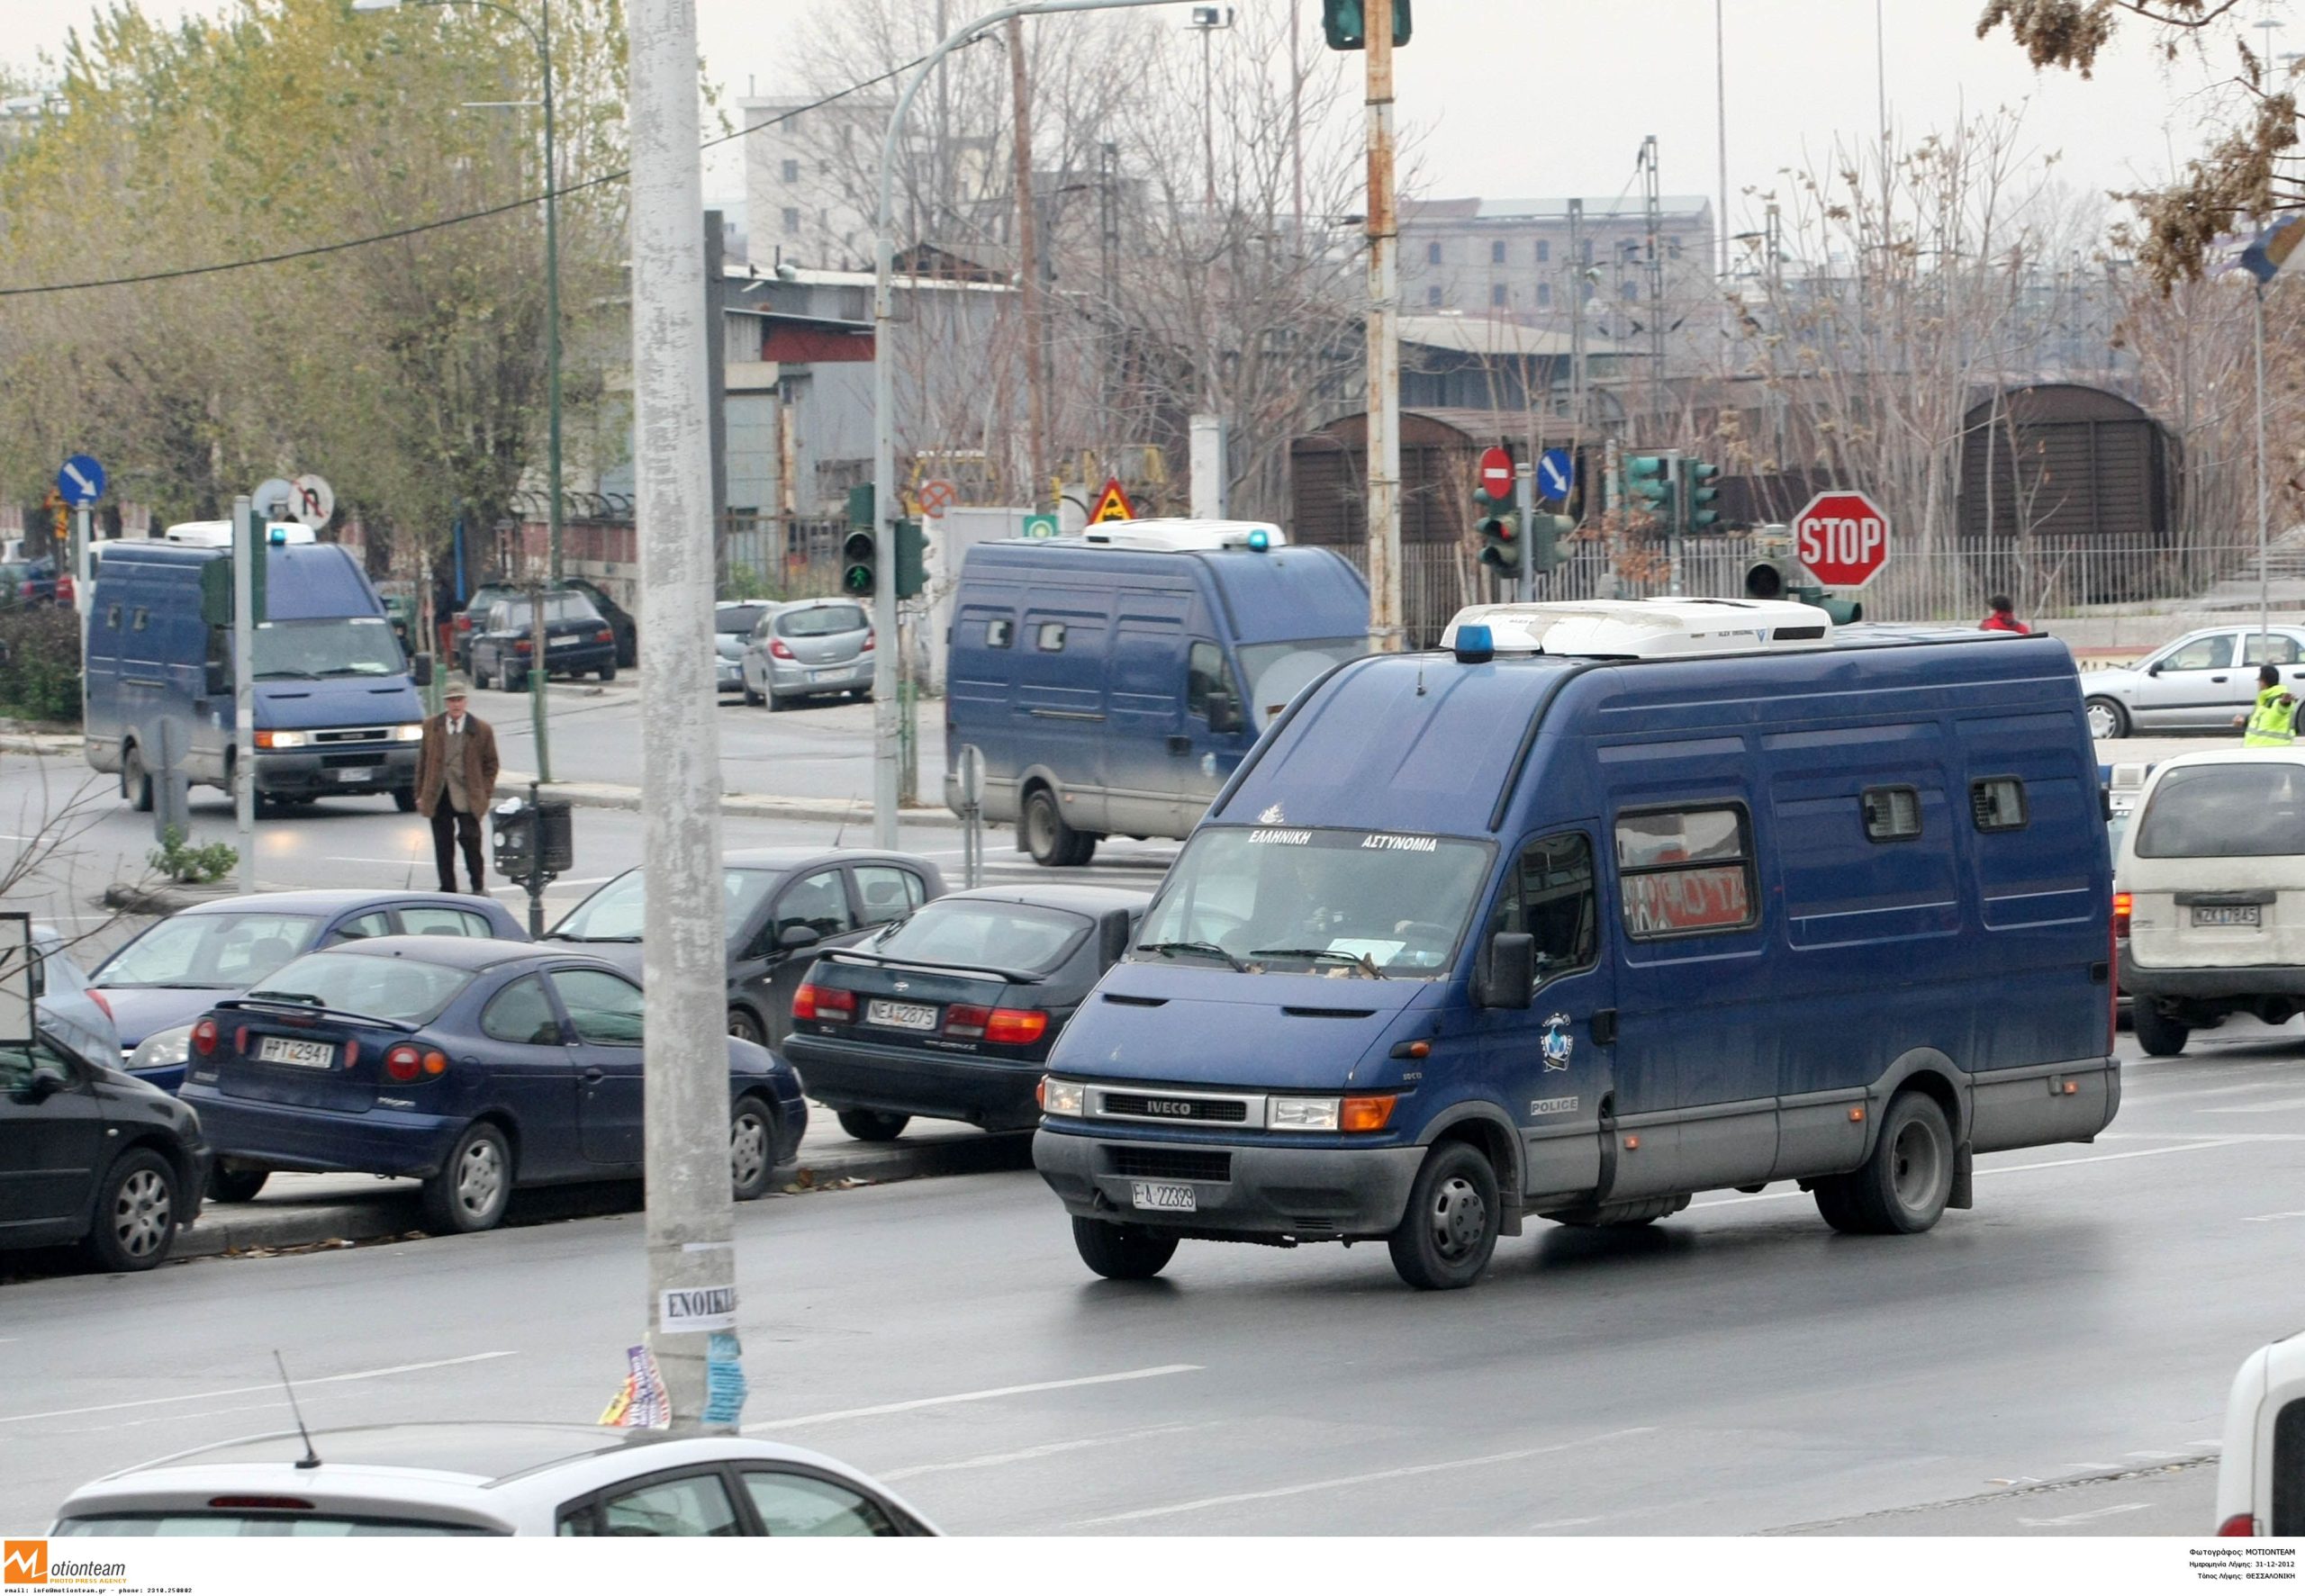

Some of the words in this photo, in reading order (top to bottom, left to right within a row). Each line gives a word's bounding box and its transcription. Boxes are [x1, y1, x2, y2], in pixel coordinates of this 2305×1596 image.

[1801, 518, 1881, 564] STOP
[1248, 830, 1312, 845] ΕΛΛΗΝΙΚΗ
[1361, 834, 1437, 852] ΑΣΤΥΝΟΜΙΑ
[1147, 1101, 1190, 1115] IVECO
[1532, 1098, 1577, 1114] POLICE
